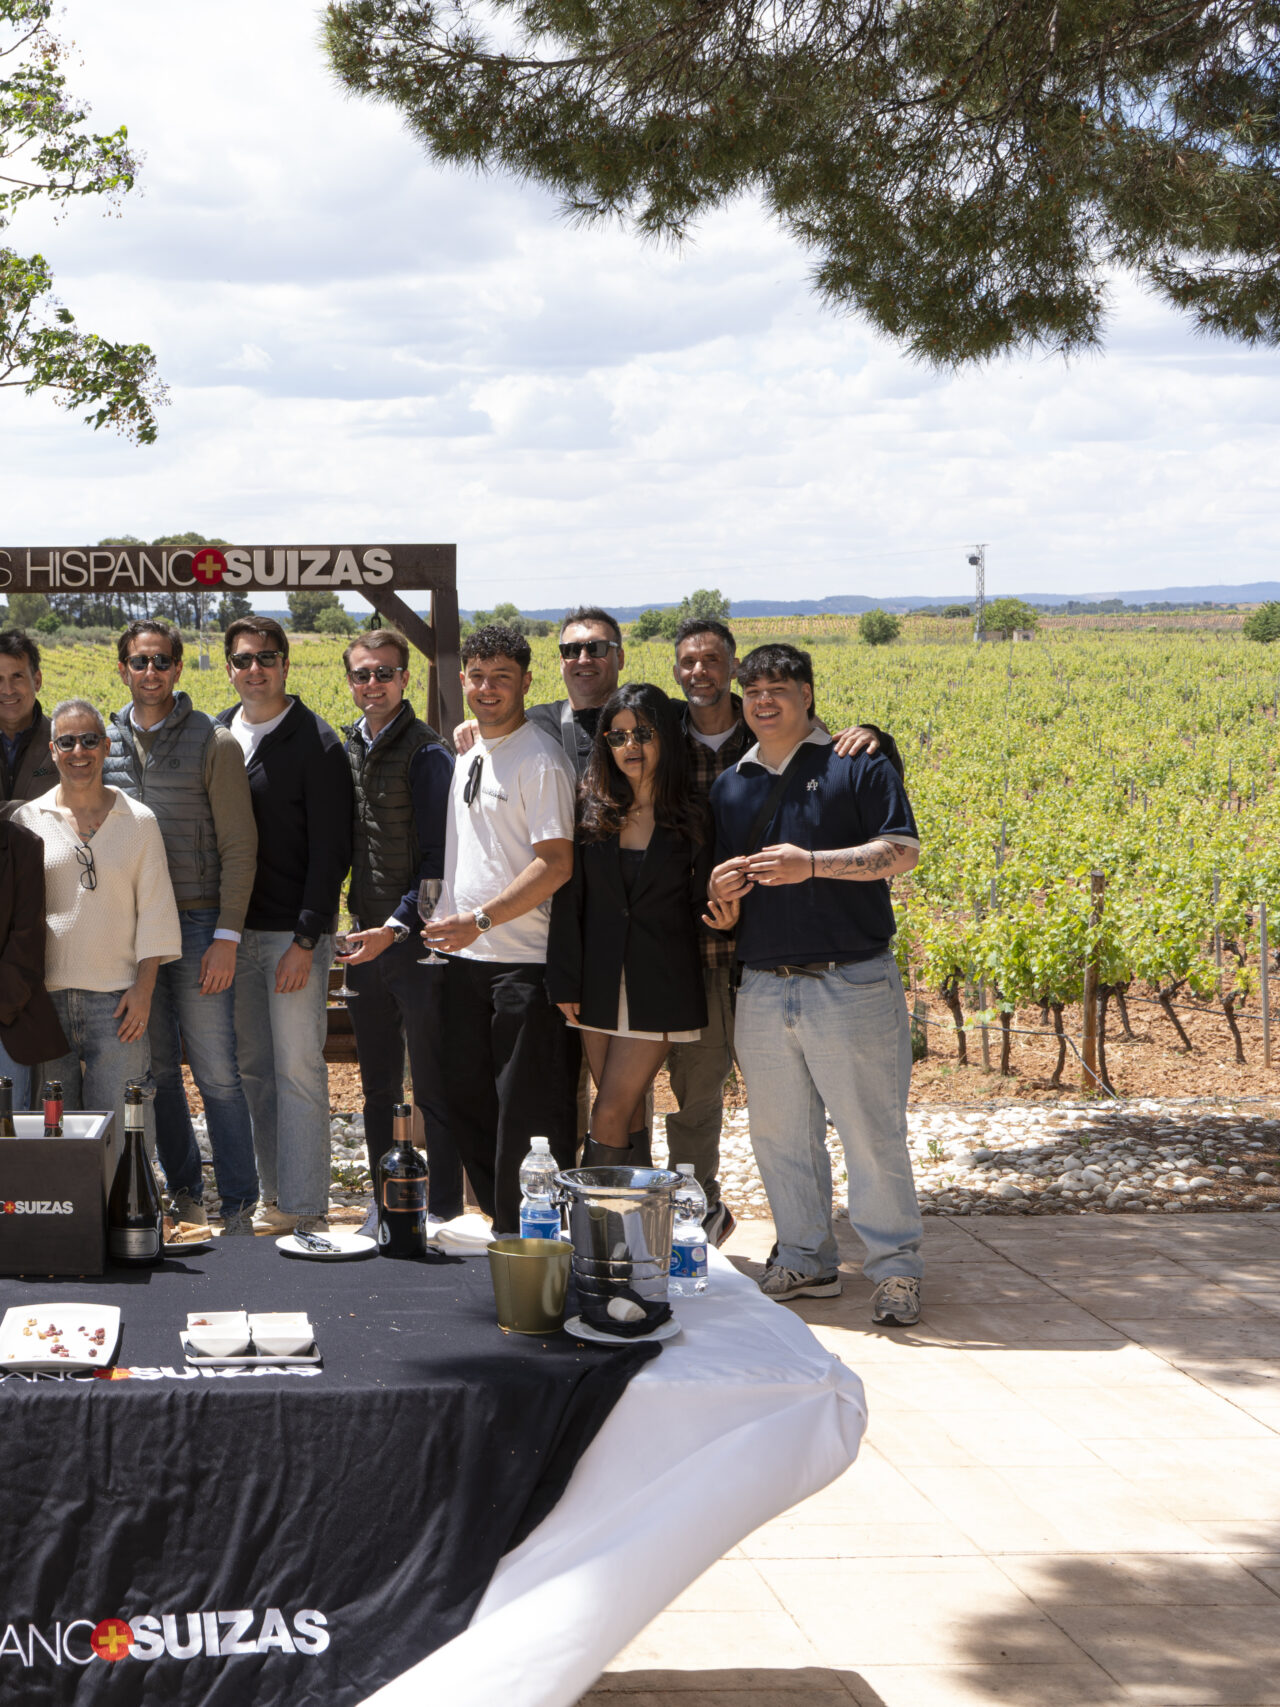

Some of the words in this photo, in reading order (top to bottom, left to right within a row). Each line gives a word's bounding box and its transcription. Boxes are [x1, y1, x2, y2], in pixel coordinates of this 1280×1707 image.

[222, 549, 393, 586] SUIZAS
[15, 1200, 74, 1215] SUIZAS
[128, 1609, 330, 1660] SUIZAS
